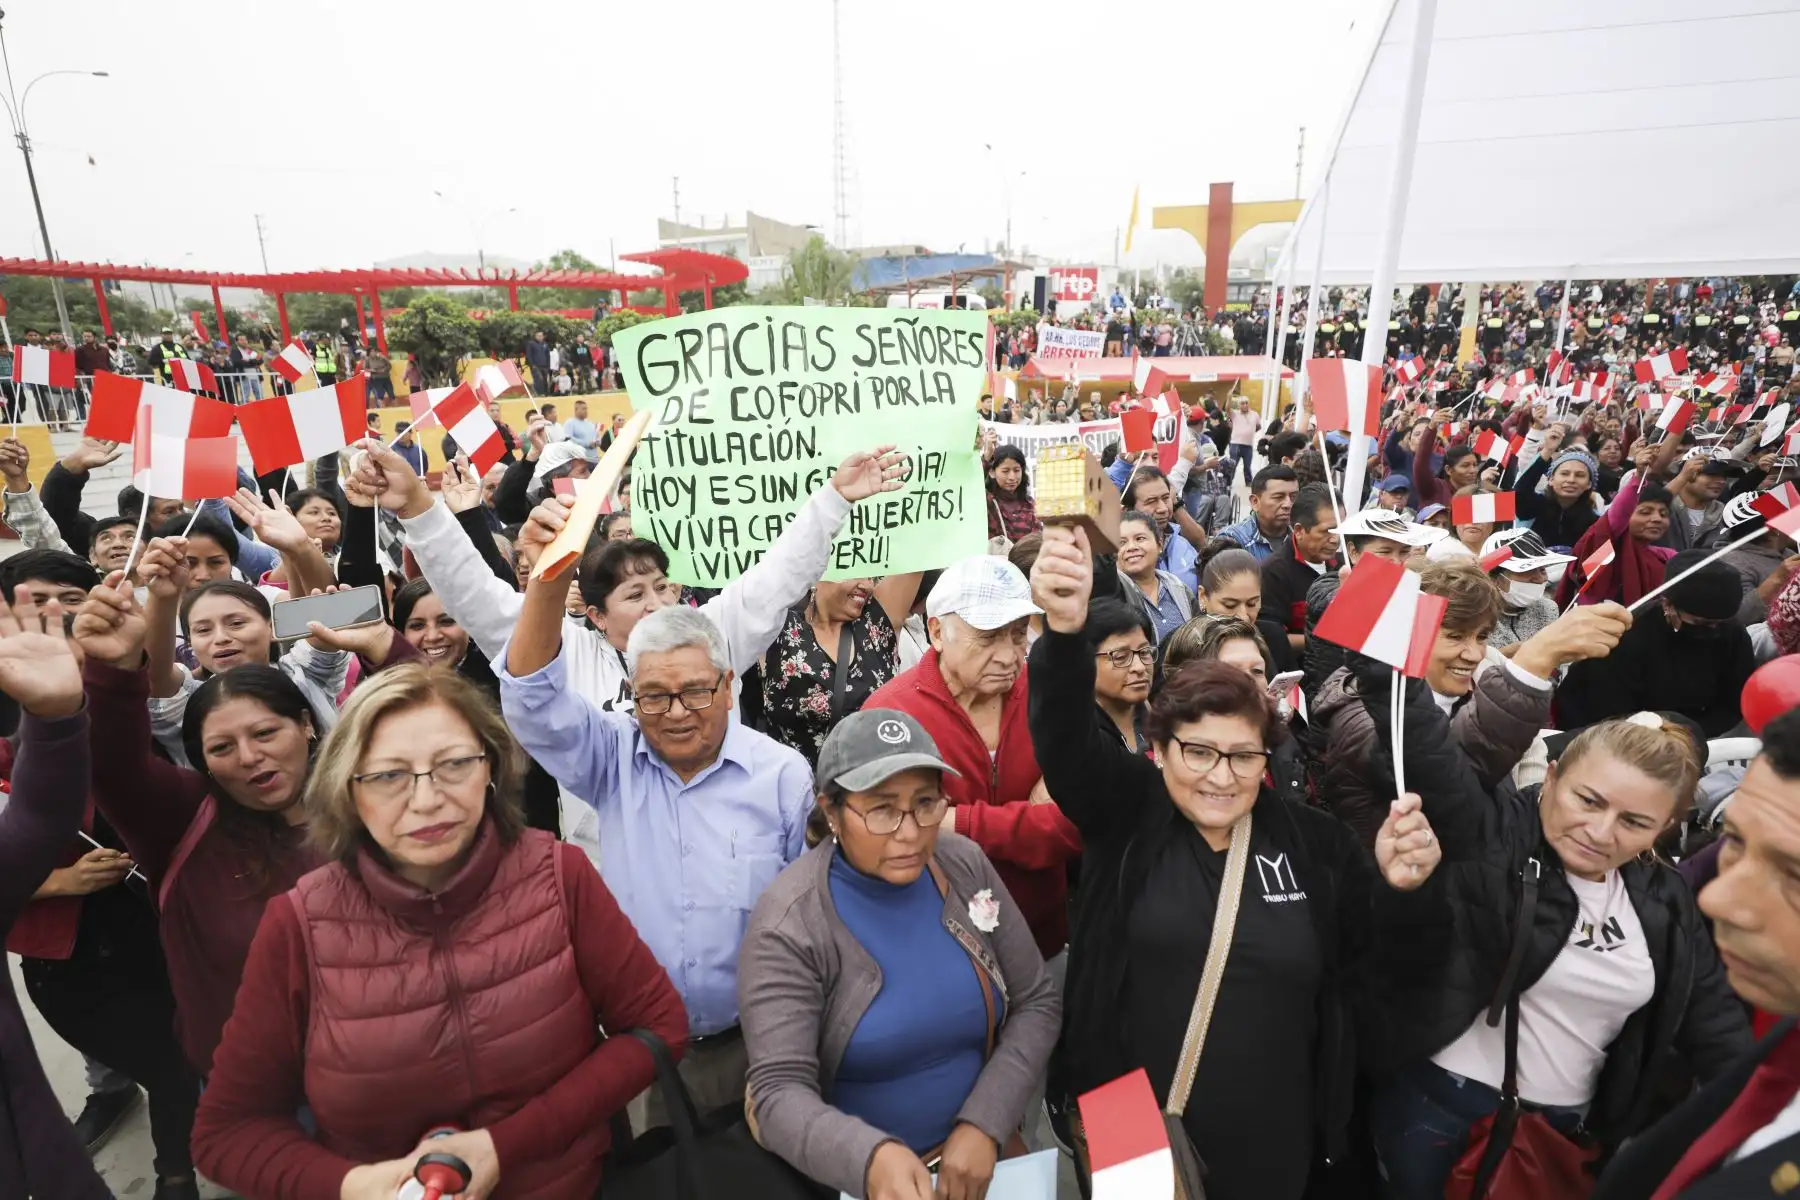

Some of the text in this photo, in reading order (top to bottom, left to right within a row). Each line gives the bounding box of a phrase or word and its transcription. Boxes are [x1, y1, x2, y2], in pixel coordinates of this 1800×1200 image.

[637, 316, 983, 396] GRACIAS SEÑORES
[658, 369, 955, 425] DE COFOPRI POR LA
[850, 486, 964, 537] HUERTAS!
